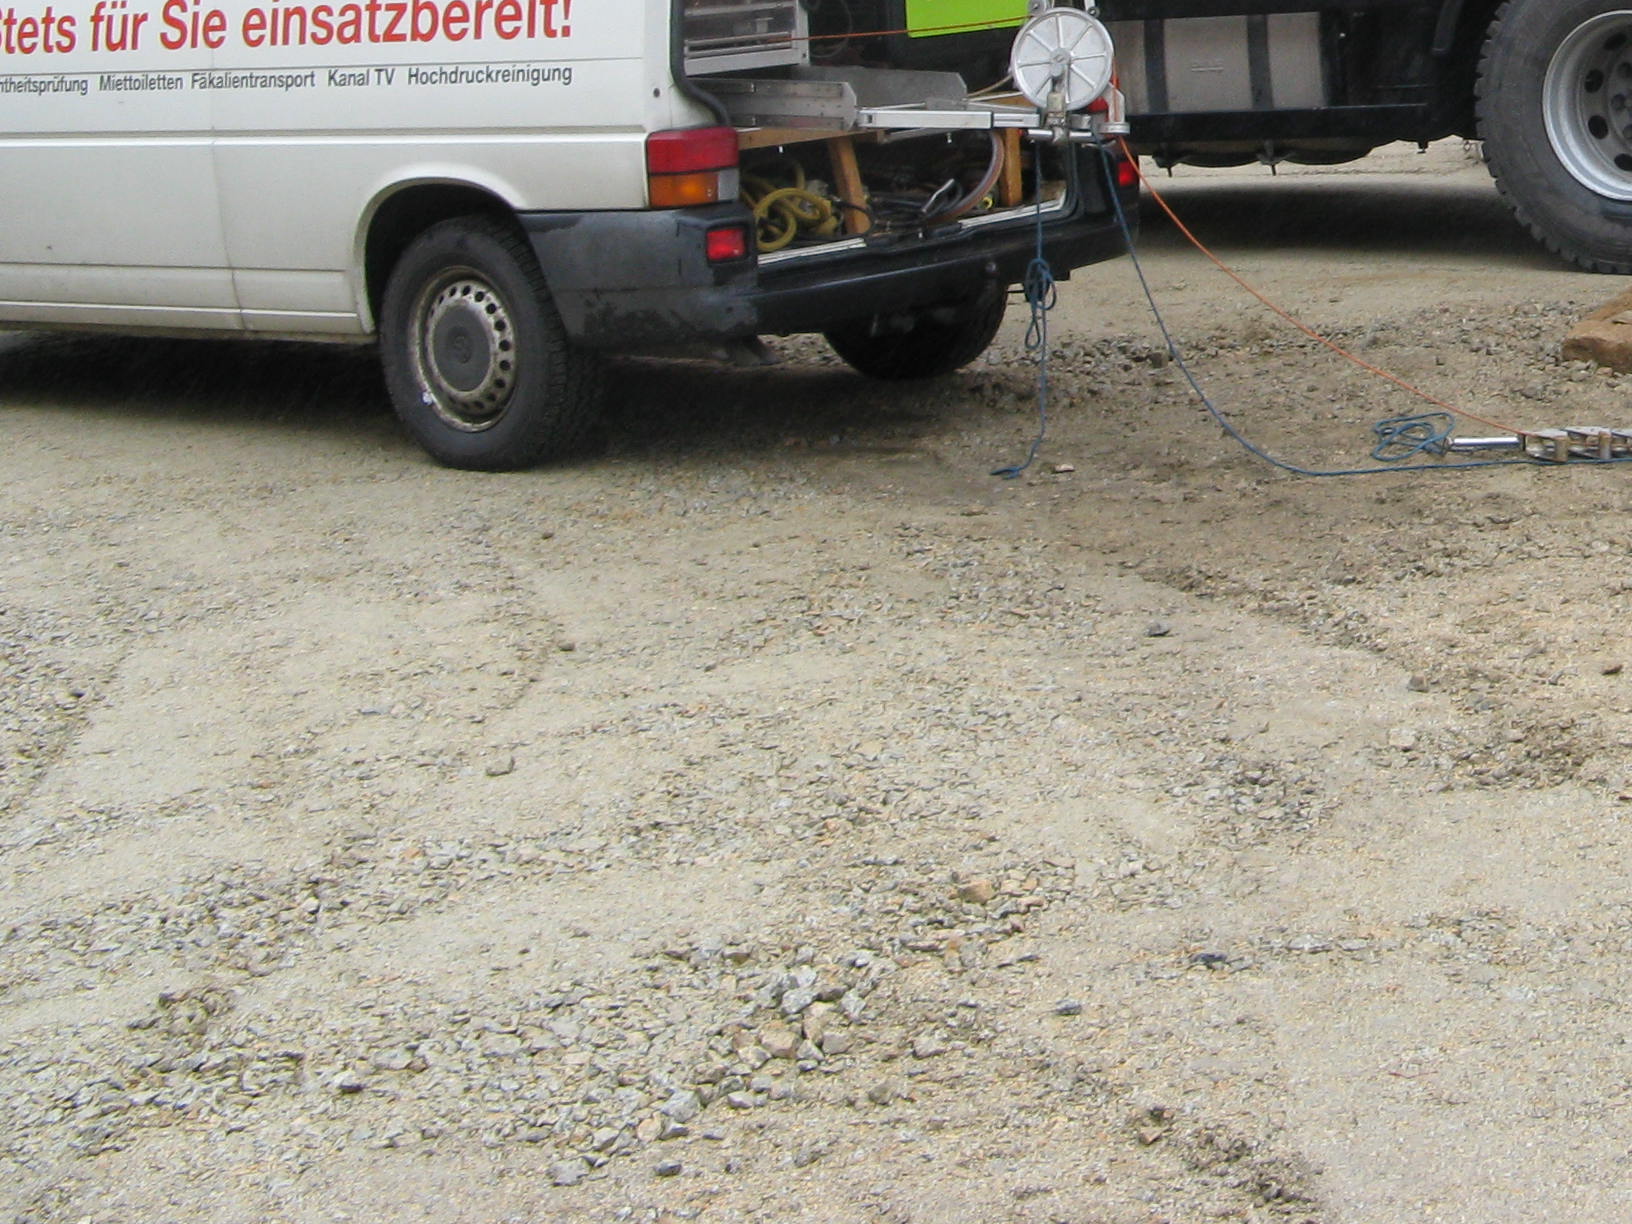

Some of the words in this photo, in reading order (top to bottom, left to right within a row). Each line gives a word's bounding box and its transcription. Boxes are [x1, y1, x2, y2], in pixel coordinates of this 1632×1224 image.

[0, 6, 77, 55] tets
[90, 0, 149, 52] für
[99, 74, 183, 92] Miettoiletten
[191, 71, 315, 92] Fäkalientransport
[327, 68, 369, 87] Kanal
[374, 67, 396, 86] TV
[407, 64, 573, 87] Hochdruckreinigung
